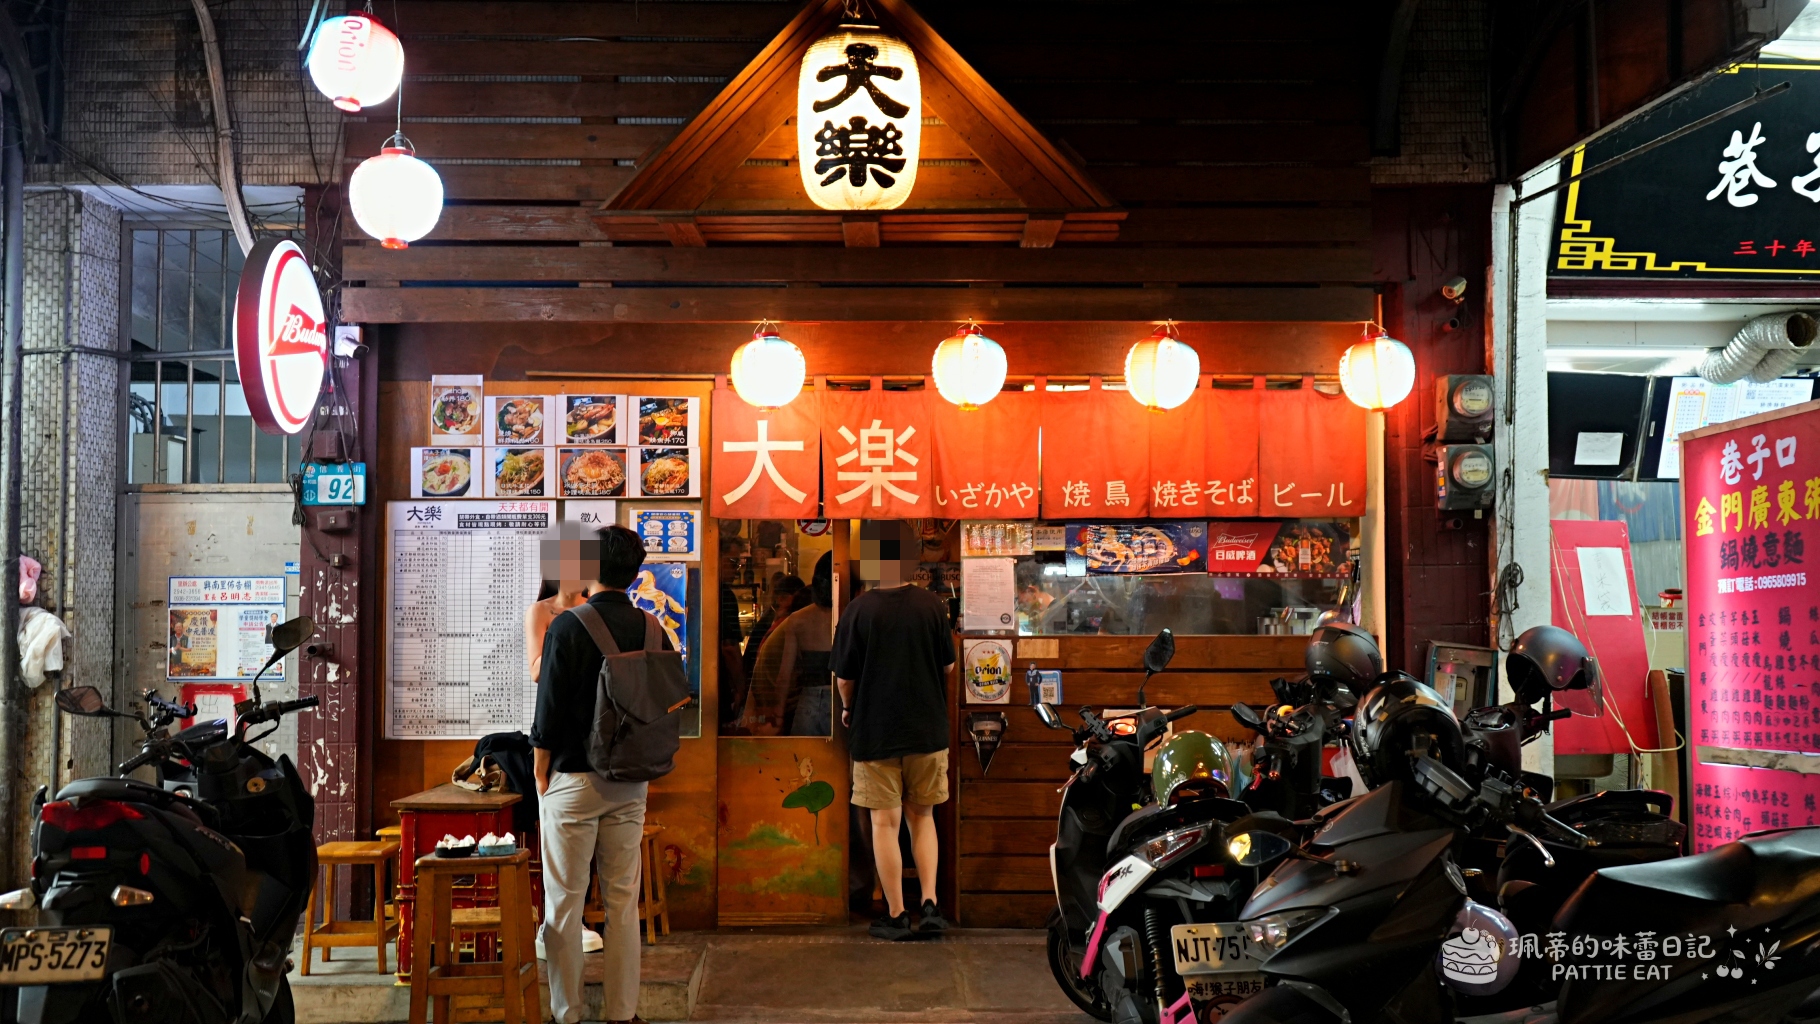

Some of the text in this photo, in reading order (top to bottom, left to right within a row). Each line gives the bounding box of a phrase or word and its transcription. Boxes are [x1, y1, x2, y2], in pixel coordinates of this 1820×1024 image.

[812, 42, 911, 189] 大樂
[1734, 239, 1816, 258] 三十年
[1719, 433, 1797, 486] 巷子口
[328, 478, 353, 500] 92
[935, 482, 1034, 508] いざかや
[1152, 477, 1255, 508] 焼きそば
[1273, 482, 1353, 508] ビール
[406, 505, 442, 522] 大樂
[498, 502, 549, 512] 天天都有開
[580, 512, 602, 524] 徵人
[1217, 535, 1254, 546] Budweiser
[1720, 530, 1805, 572] 鍋燒意麵
[203, 580, 252, 591] 興南里佈告欄
[940, 573, 961, 581] BUSC
